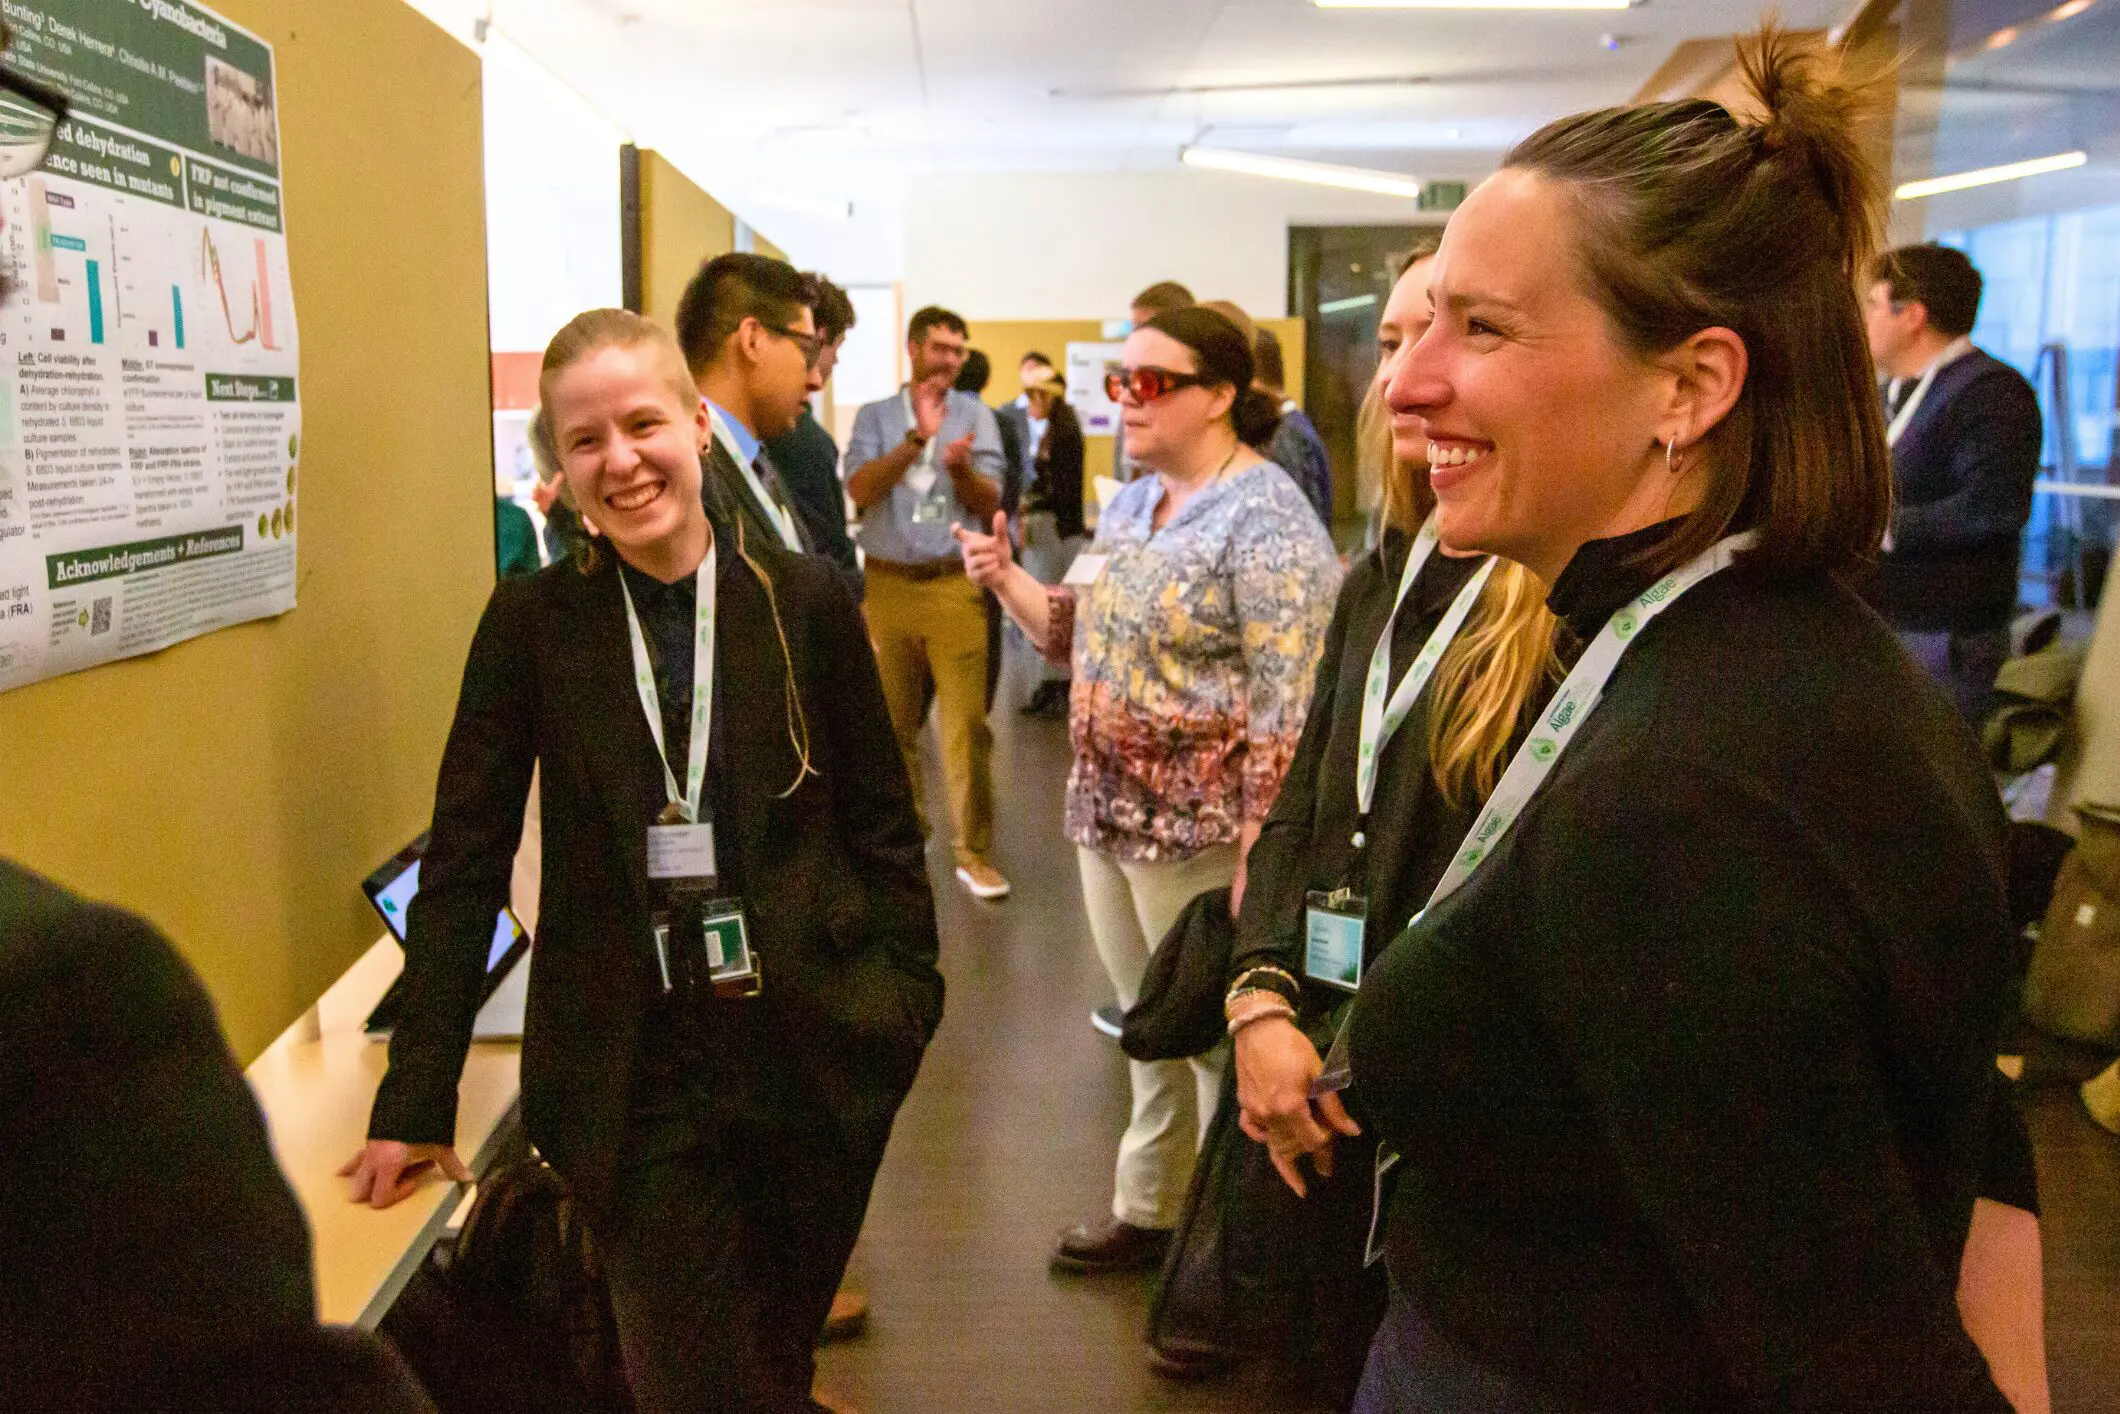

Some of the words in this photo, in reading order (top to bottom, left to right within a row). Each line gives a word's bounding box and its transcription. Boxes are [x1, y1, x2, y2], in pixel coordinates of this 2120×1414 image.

[75, 126, 151, 167] dehydration
[80, 161, 112, 183] seen
[113, 166, 127, 187] in
[38, 352, 52, 363] Cell
[54, 355, 80, 368] viability
[20, 384, 29, 397] A)
[31, 385, 59, 399] Average
[48, 401, 57, 414] by
[25, 449, 34, 461] B)
[27, 480, 78, 492] Measurements
[57, 549, 175, 582] Acknowledgements
[186, 535, 241, 556] References
[12, 586, 30, 601] light
[1639, 573, 1678, 609] Algae
[7, 602, 33, 619] (FRA)
[1550, 701, 1576, 733] Algae
[1477, 814, 1501, 843] Algae
